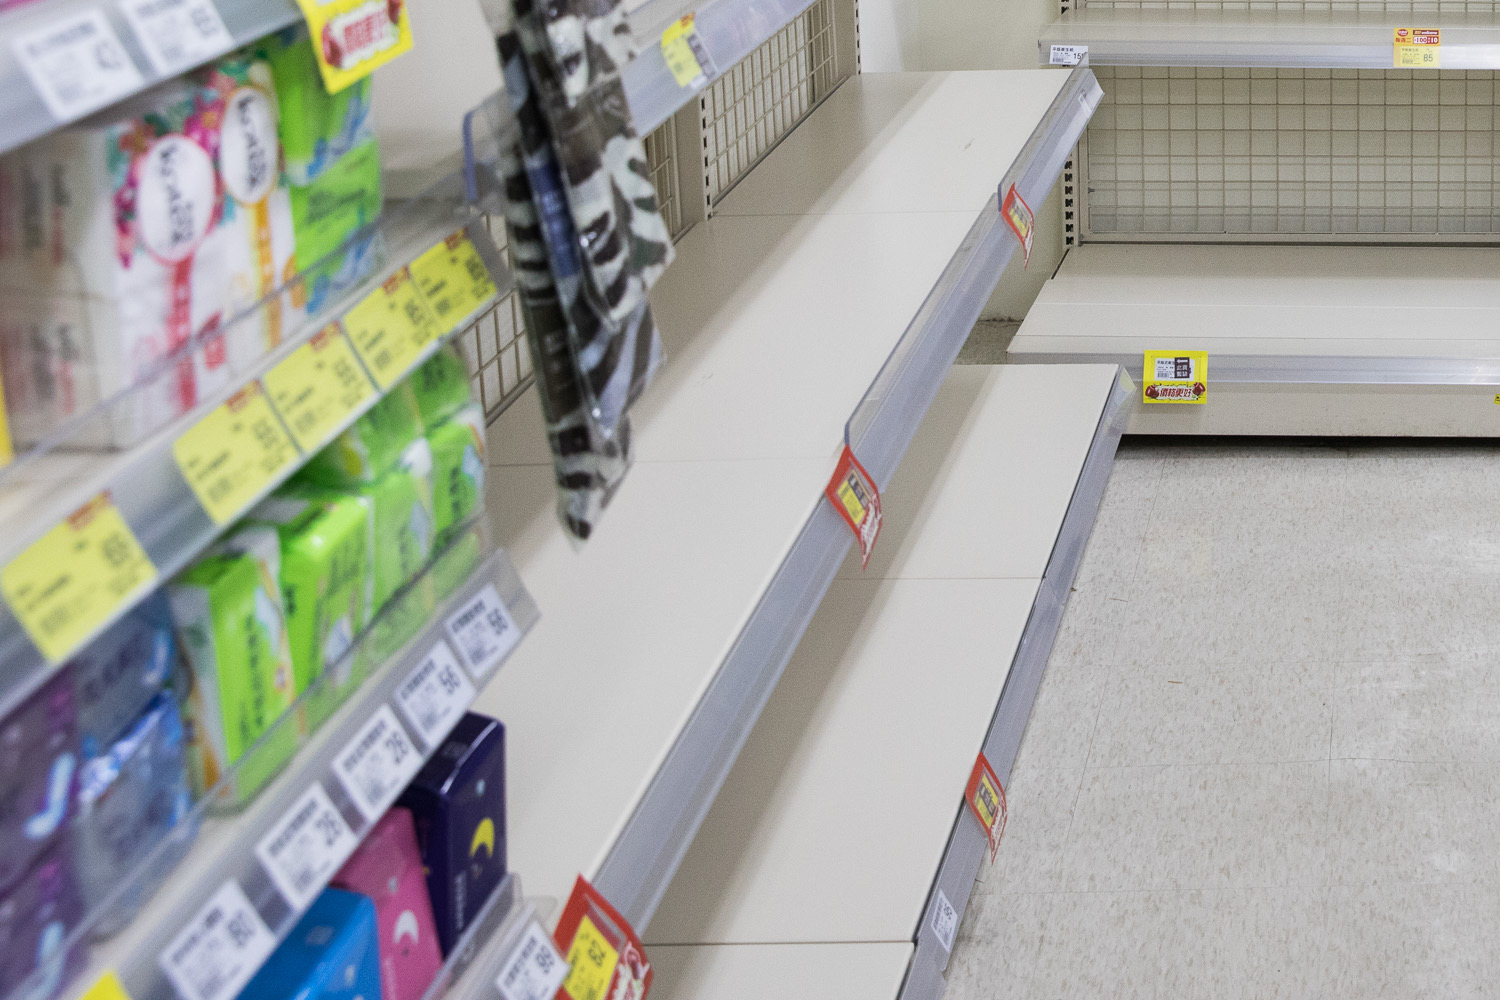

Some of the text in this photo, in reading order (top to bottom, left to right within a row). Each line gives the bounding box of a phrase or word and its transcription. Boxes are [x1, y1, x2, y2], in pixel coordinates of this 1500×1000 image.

[1424, 54, 1433, 62] 85
[1160, 388, 1191, 397] 價格更好
